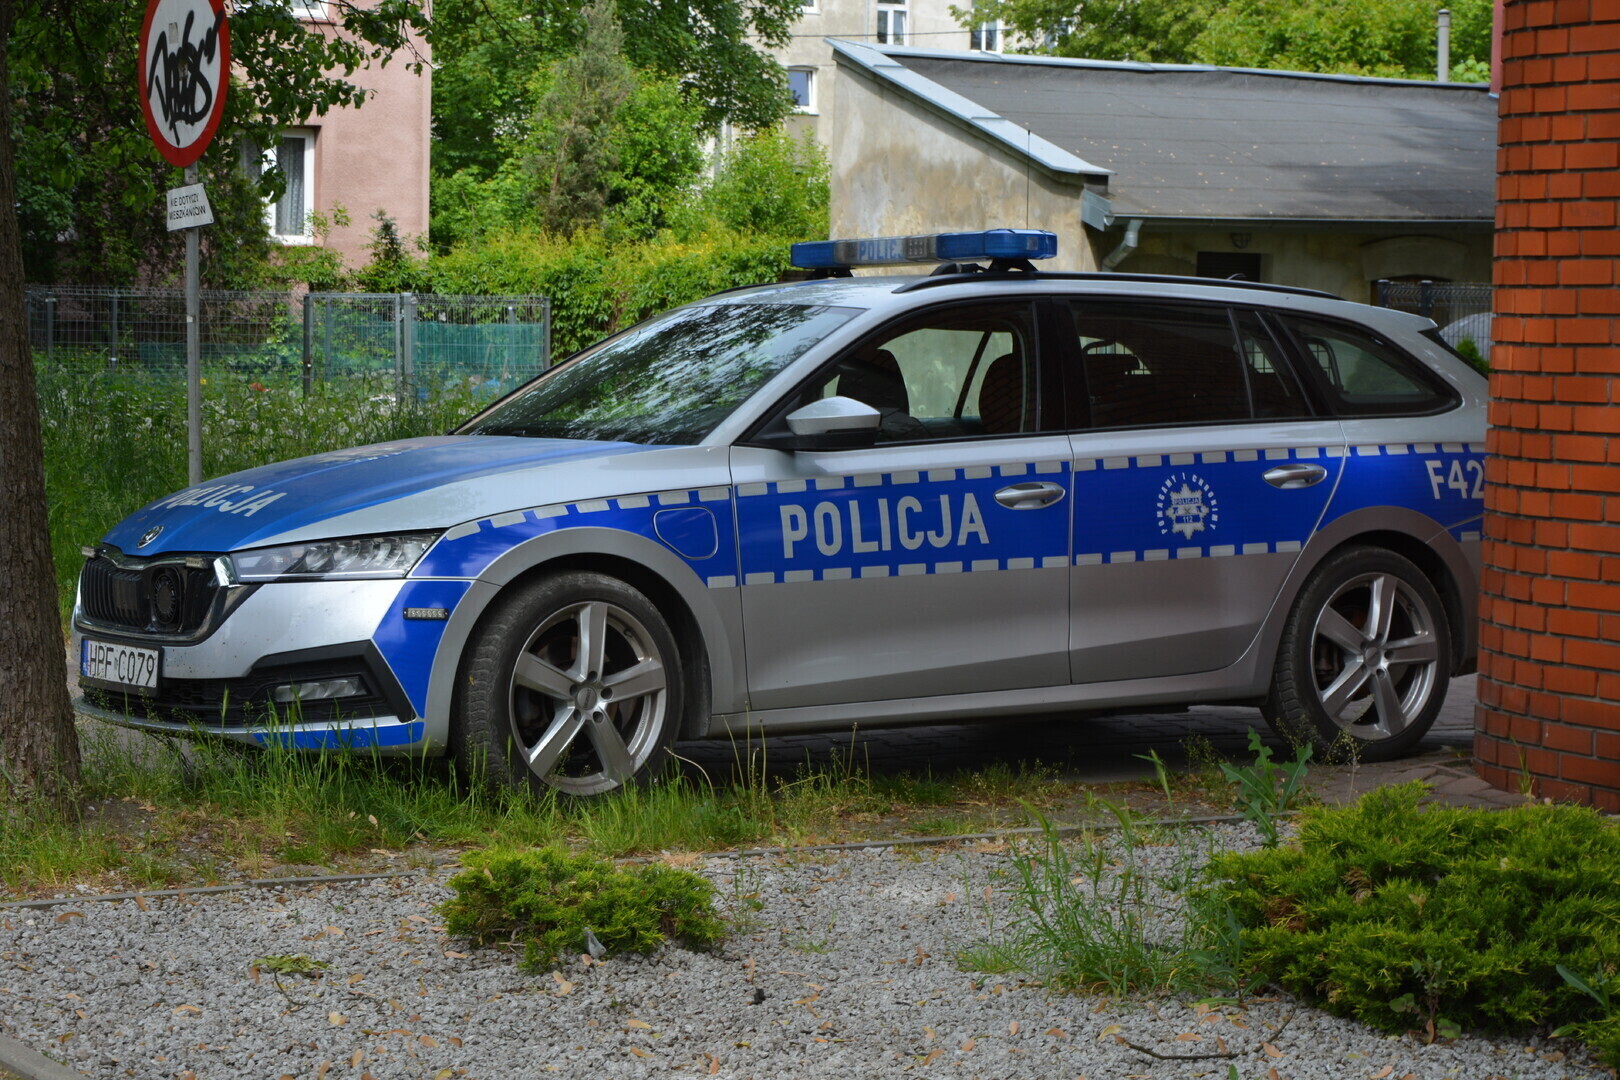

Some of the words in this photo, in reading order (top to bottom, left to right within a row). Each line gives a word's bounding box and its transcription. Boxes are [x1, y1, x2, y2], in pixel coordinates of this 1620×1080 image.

[179, 193, 199, 206] DOTYCZY
[1425, 459, 1485, 499] F42
[150, 484, 287, 517] POLICJA
[1174, 497, 1200, 505] POLICJA
[779, 493, 990, 559] POLICJA
[1182, 515, 1193, 523] 112
[89, 643, 114, 679] HPF
[118, 649, 155, 686] C079
